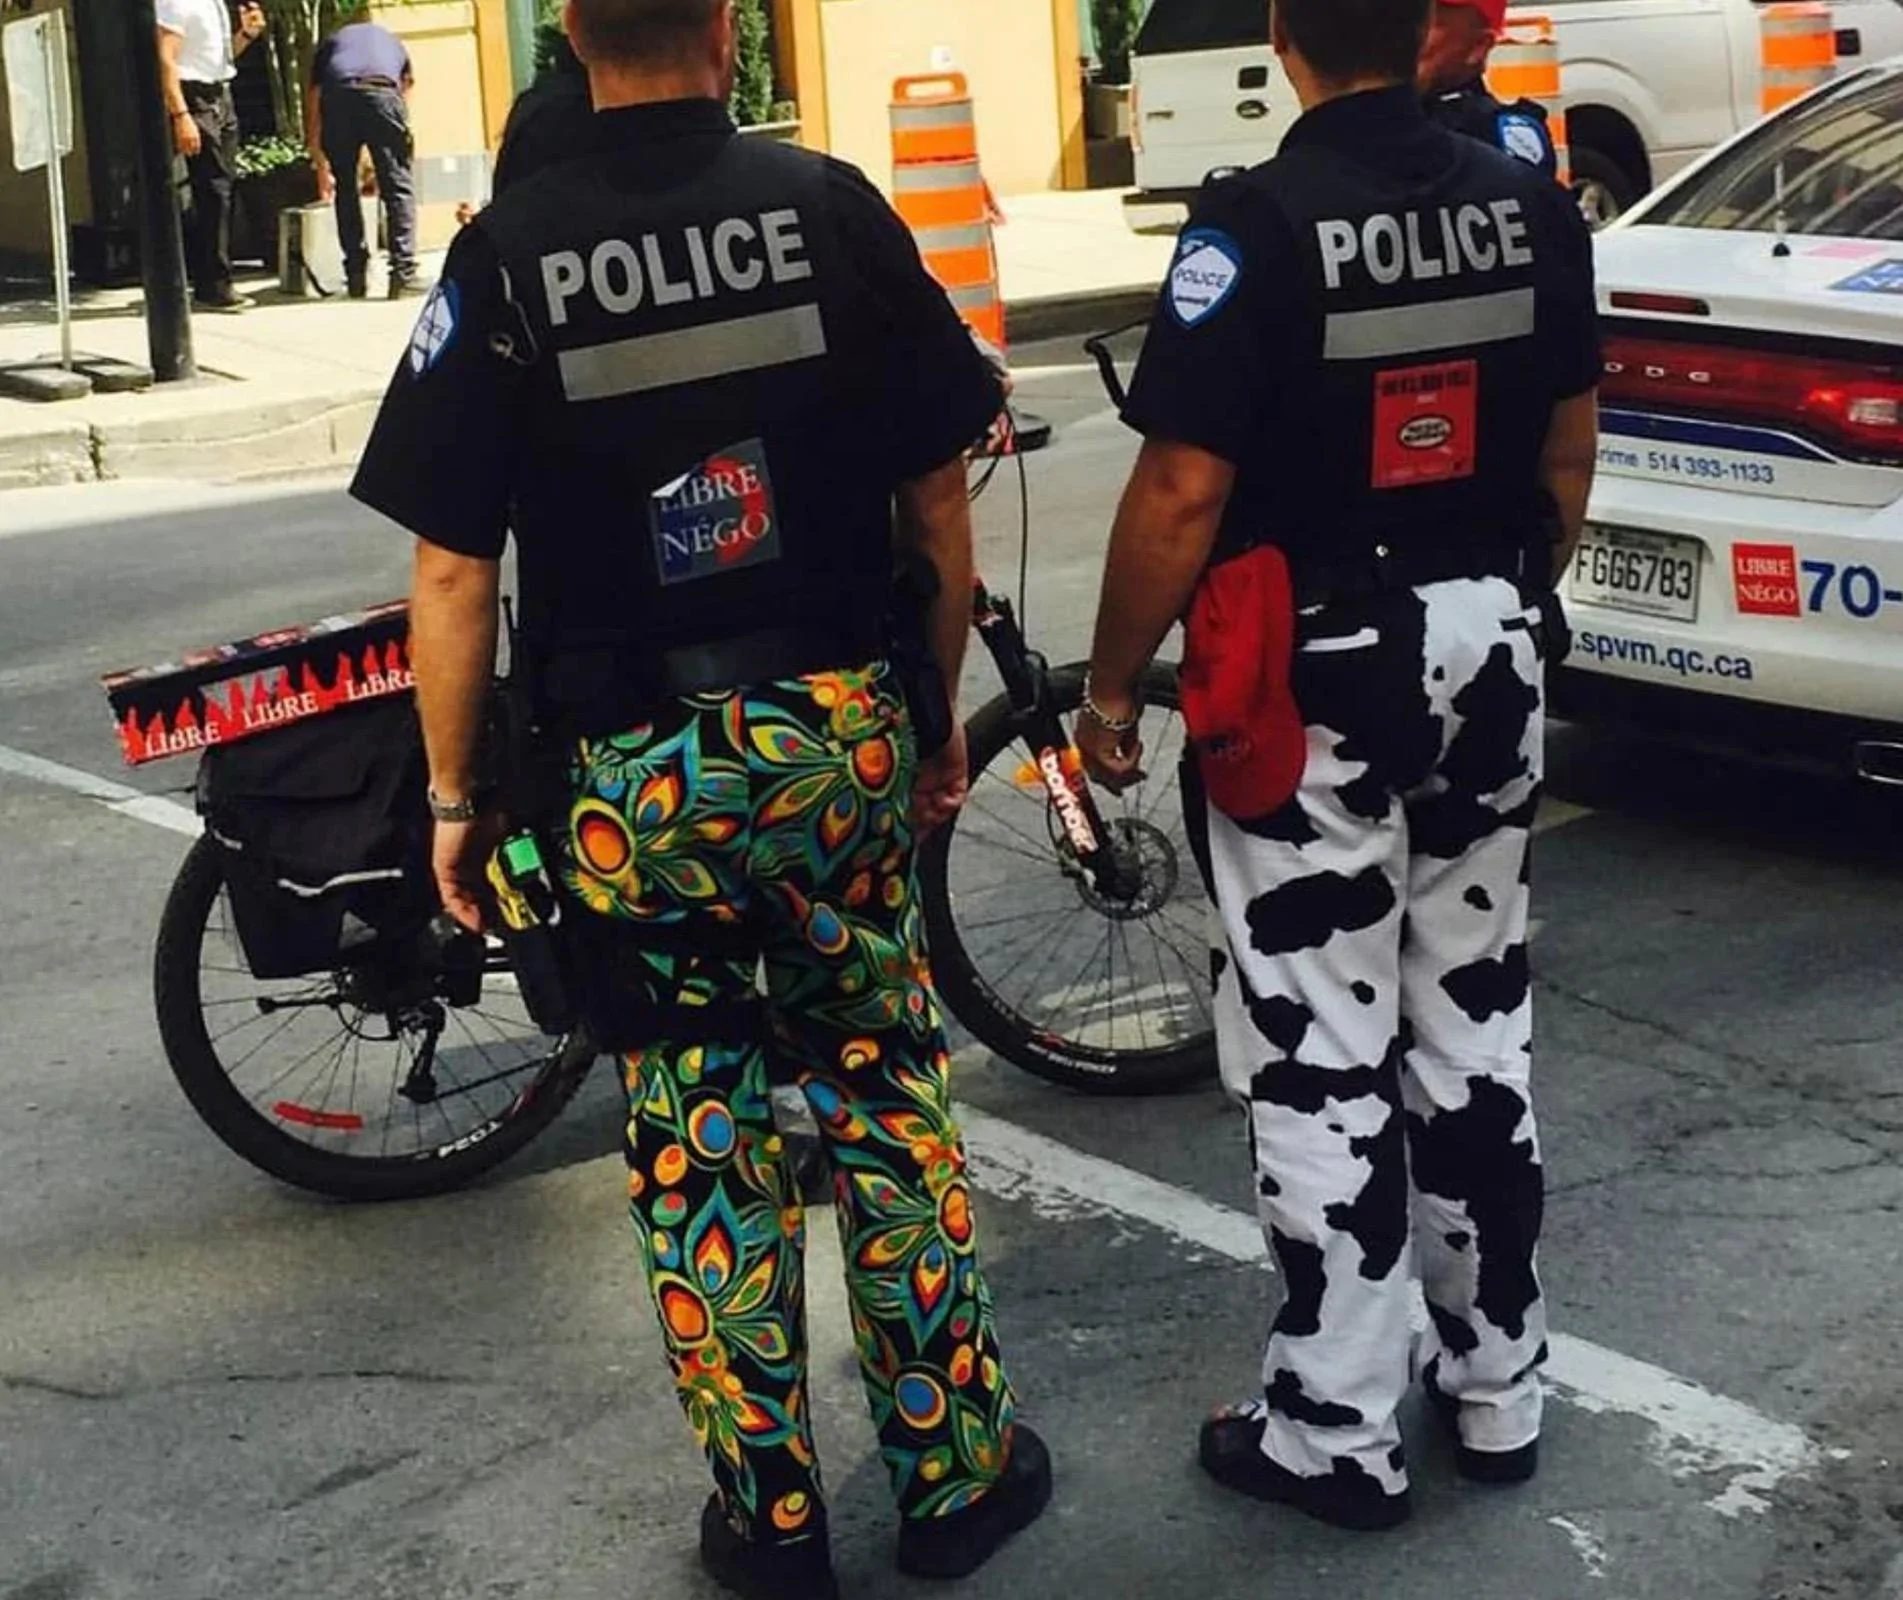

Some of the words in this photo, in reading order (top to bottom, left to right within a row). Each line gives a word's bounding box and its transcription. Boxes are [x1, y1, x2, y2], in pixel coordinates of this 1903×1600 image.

[540, 208, 813, 326] POLICE
[1316, 199, 1534, 289] POLICE
[1176, 267, 1229, 289] POLICE
[1600, 447, 1639, 468] rime
[1648, 451, 1680, 472] 514
[1684, 456, 1775, 484] 393-1133
[660, 511, 770, 561] NÉGO
[1576, 543, 1693, 600] FGG6783
[1737, 557, 1792, 577] LIBRE
[1801, 560, 1903, 617] 70-
[1738, 581, 1796, 604] NÉGO
[1575, 631, 1752, 681] .spvm.qc.ca
[145, 721, 222, 757] LIBRE
[242, 690, 319, 729] LIBRE
